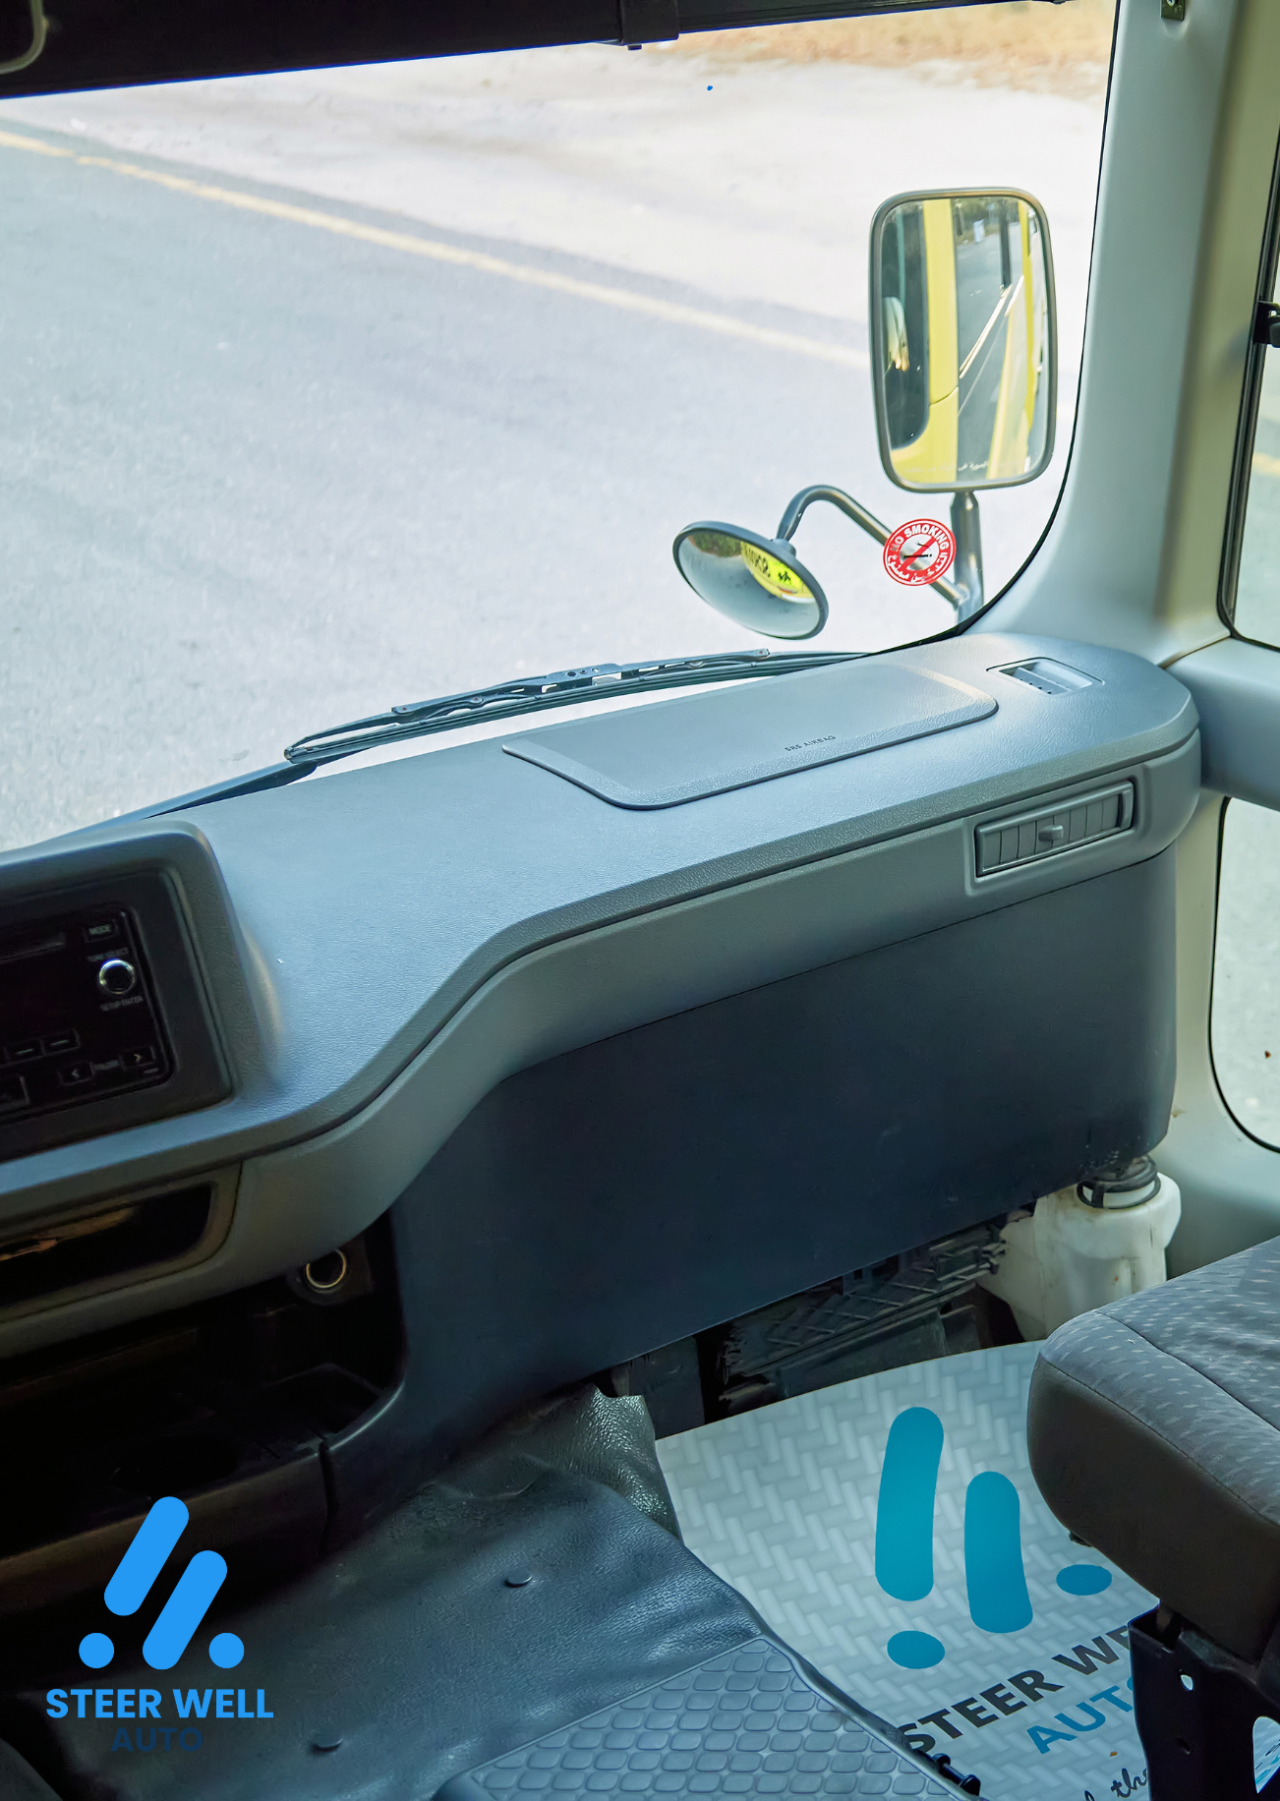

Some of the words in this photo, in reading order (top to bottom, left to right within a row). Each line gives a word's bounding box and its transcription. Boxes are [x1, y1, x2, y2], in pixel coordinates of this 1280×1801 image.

[890, 536, 905, 552] NO
[904, 524, 949, 550] SMOKING
[804, 735, 836, 746] AIRBAG
[898, 1669, 1065, 1753] STEER
